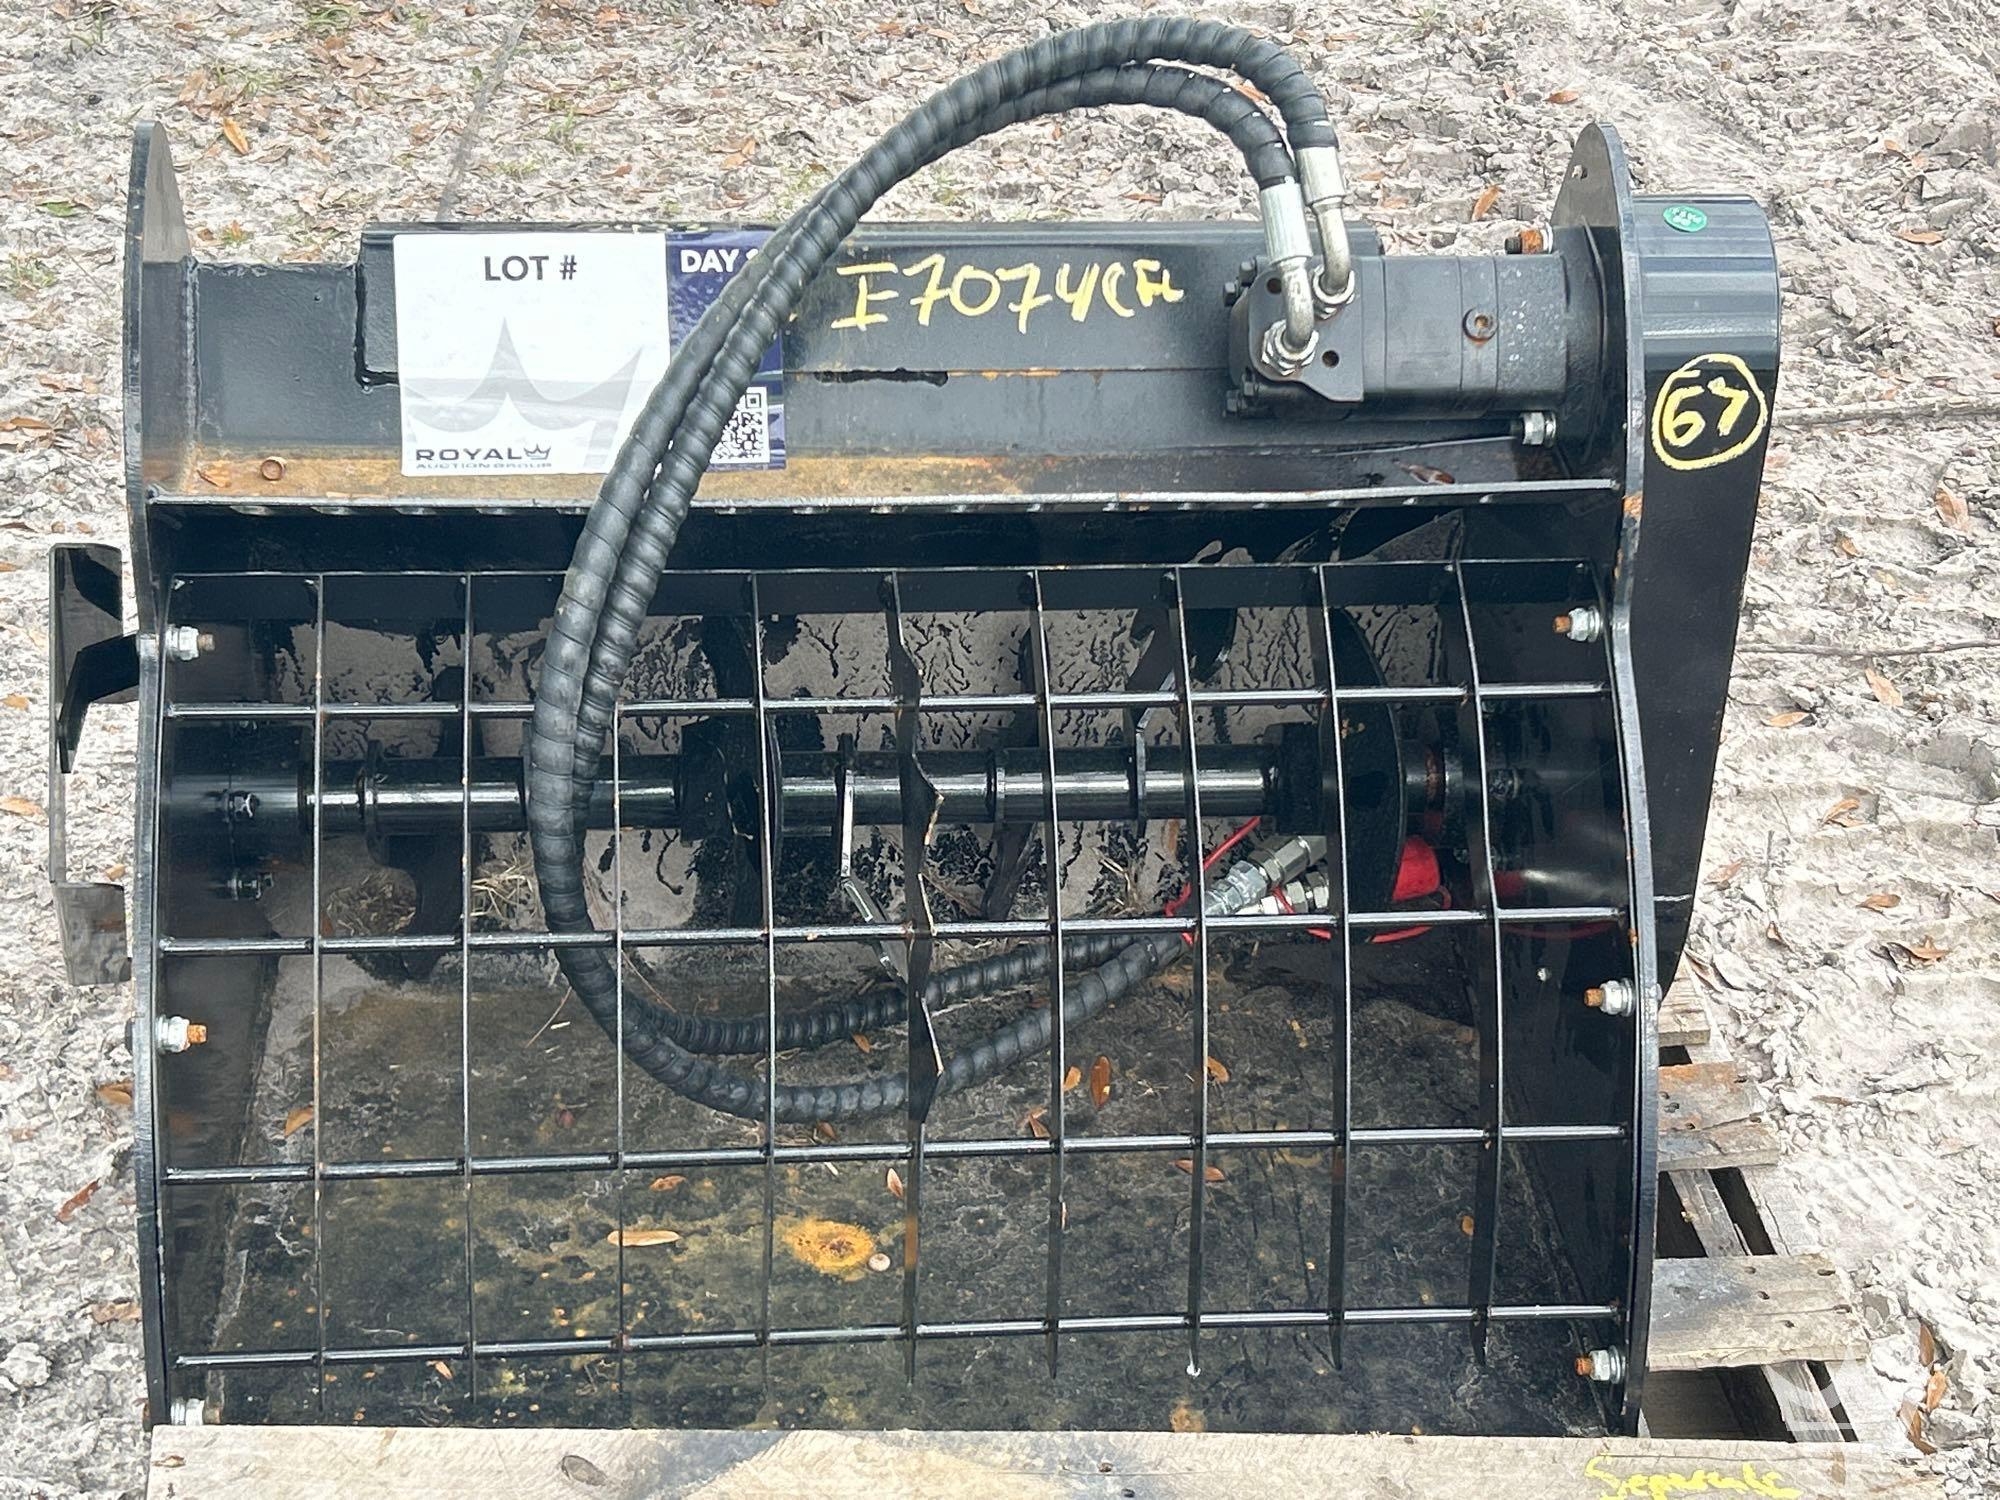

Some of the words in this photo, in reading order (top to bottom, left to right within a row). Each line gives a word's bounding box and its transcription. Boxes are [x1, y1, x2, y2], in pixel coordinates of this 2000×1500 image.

[484, 255, 549, 281] LOT
[559, 254, 578, 281] #
[680, 248, 740, 273] DAY
[1661, 377, 1749, 447] 67
[415, 447, 523, 461] ROYAL
